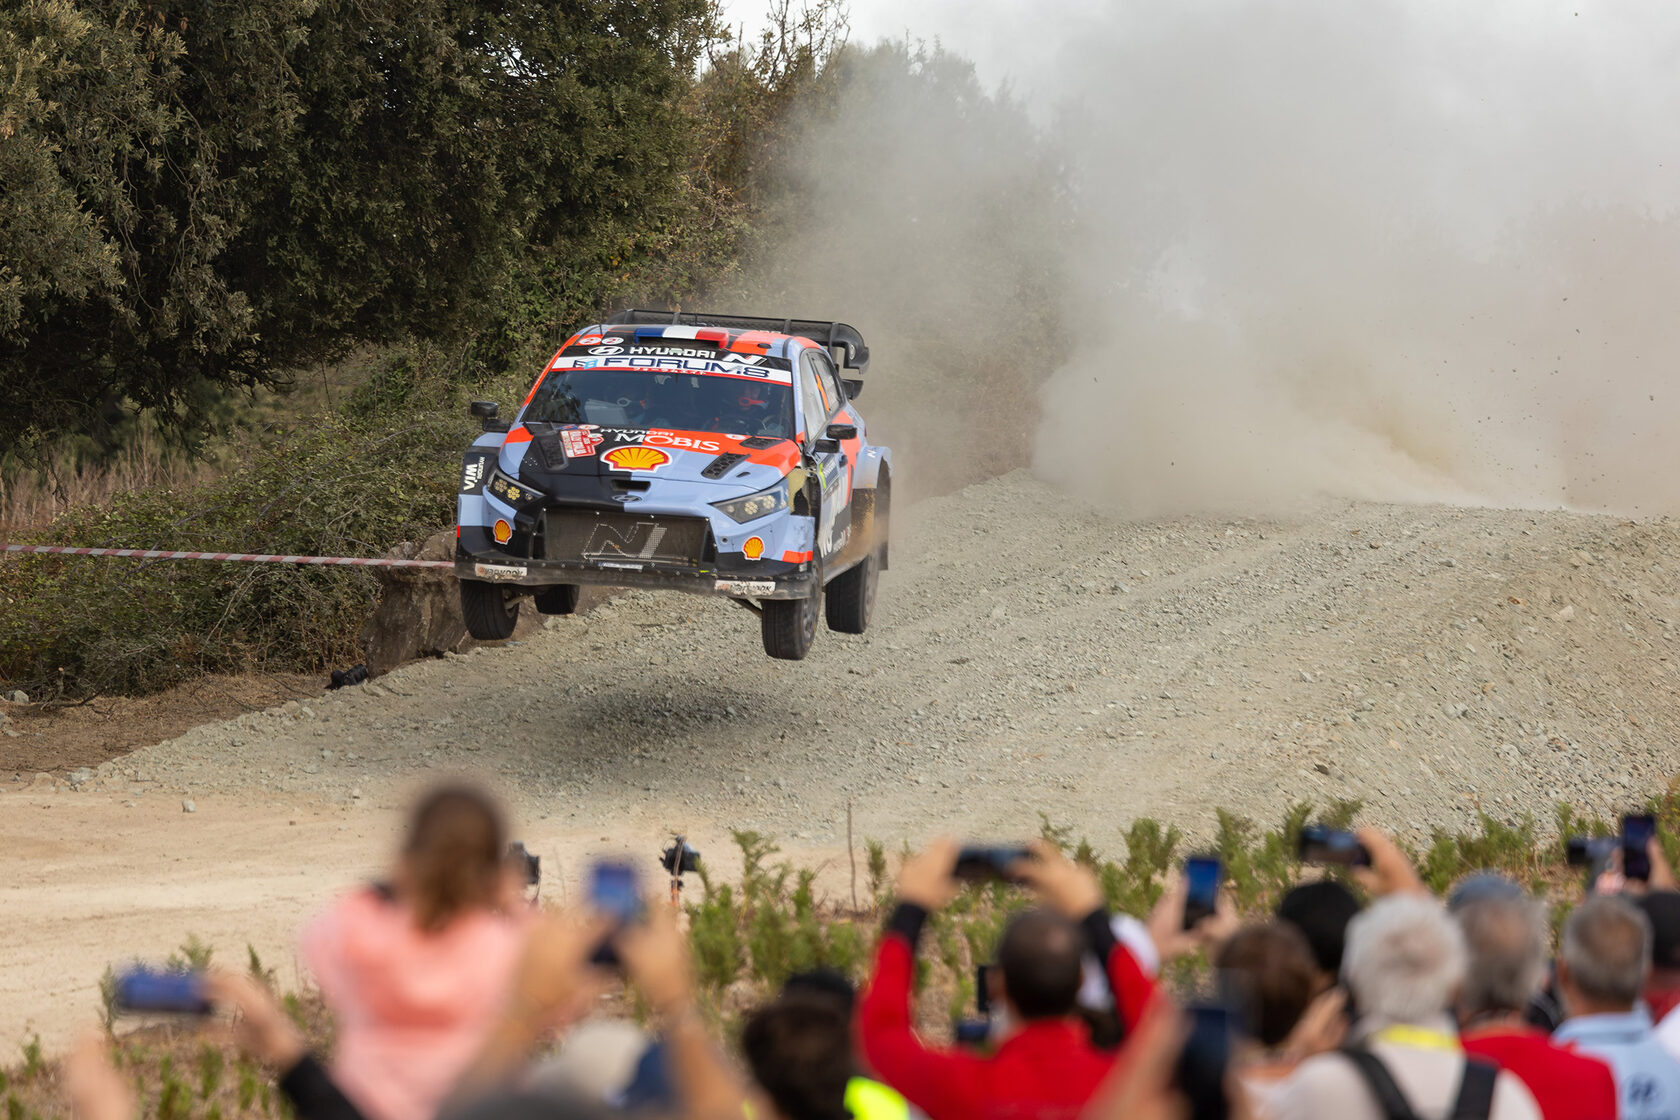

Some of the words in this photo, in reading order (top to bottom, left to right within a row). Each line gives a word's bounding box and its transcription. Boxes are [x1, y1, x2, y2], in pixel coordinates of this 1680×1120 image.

[629, 346, 716, 358] HYUNDAI
[604, 357, 769, 378] FORUM8
[600, 428, 674, 436] HYUNDAI
[614, 433, 720, 451] MOBIS
